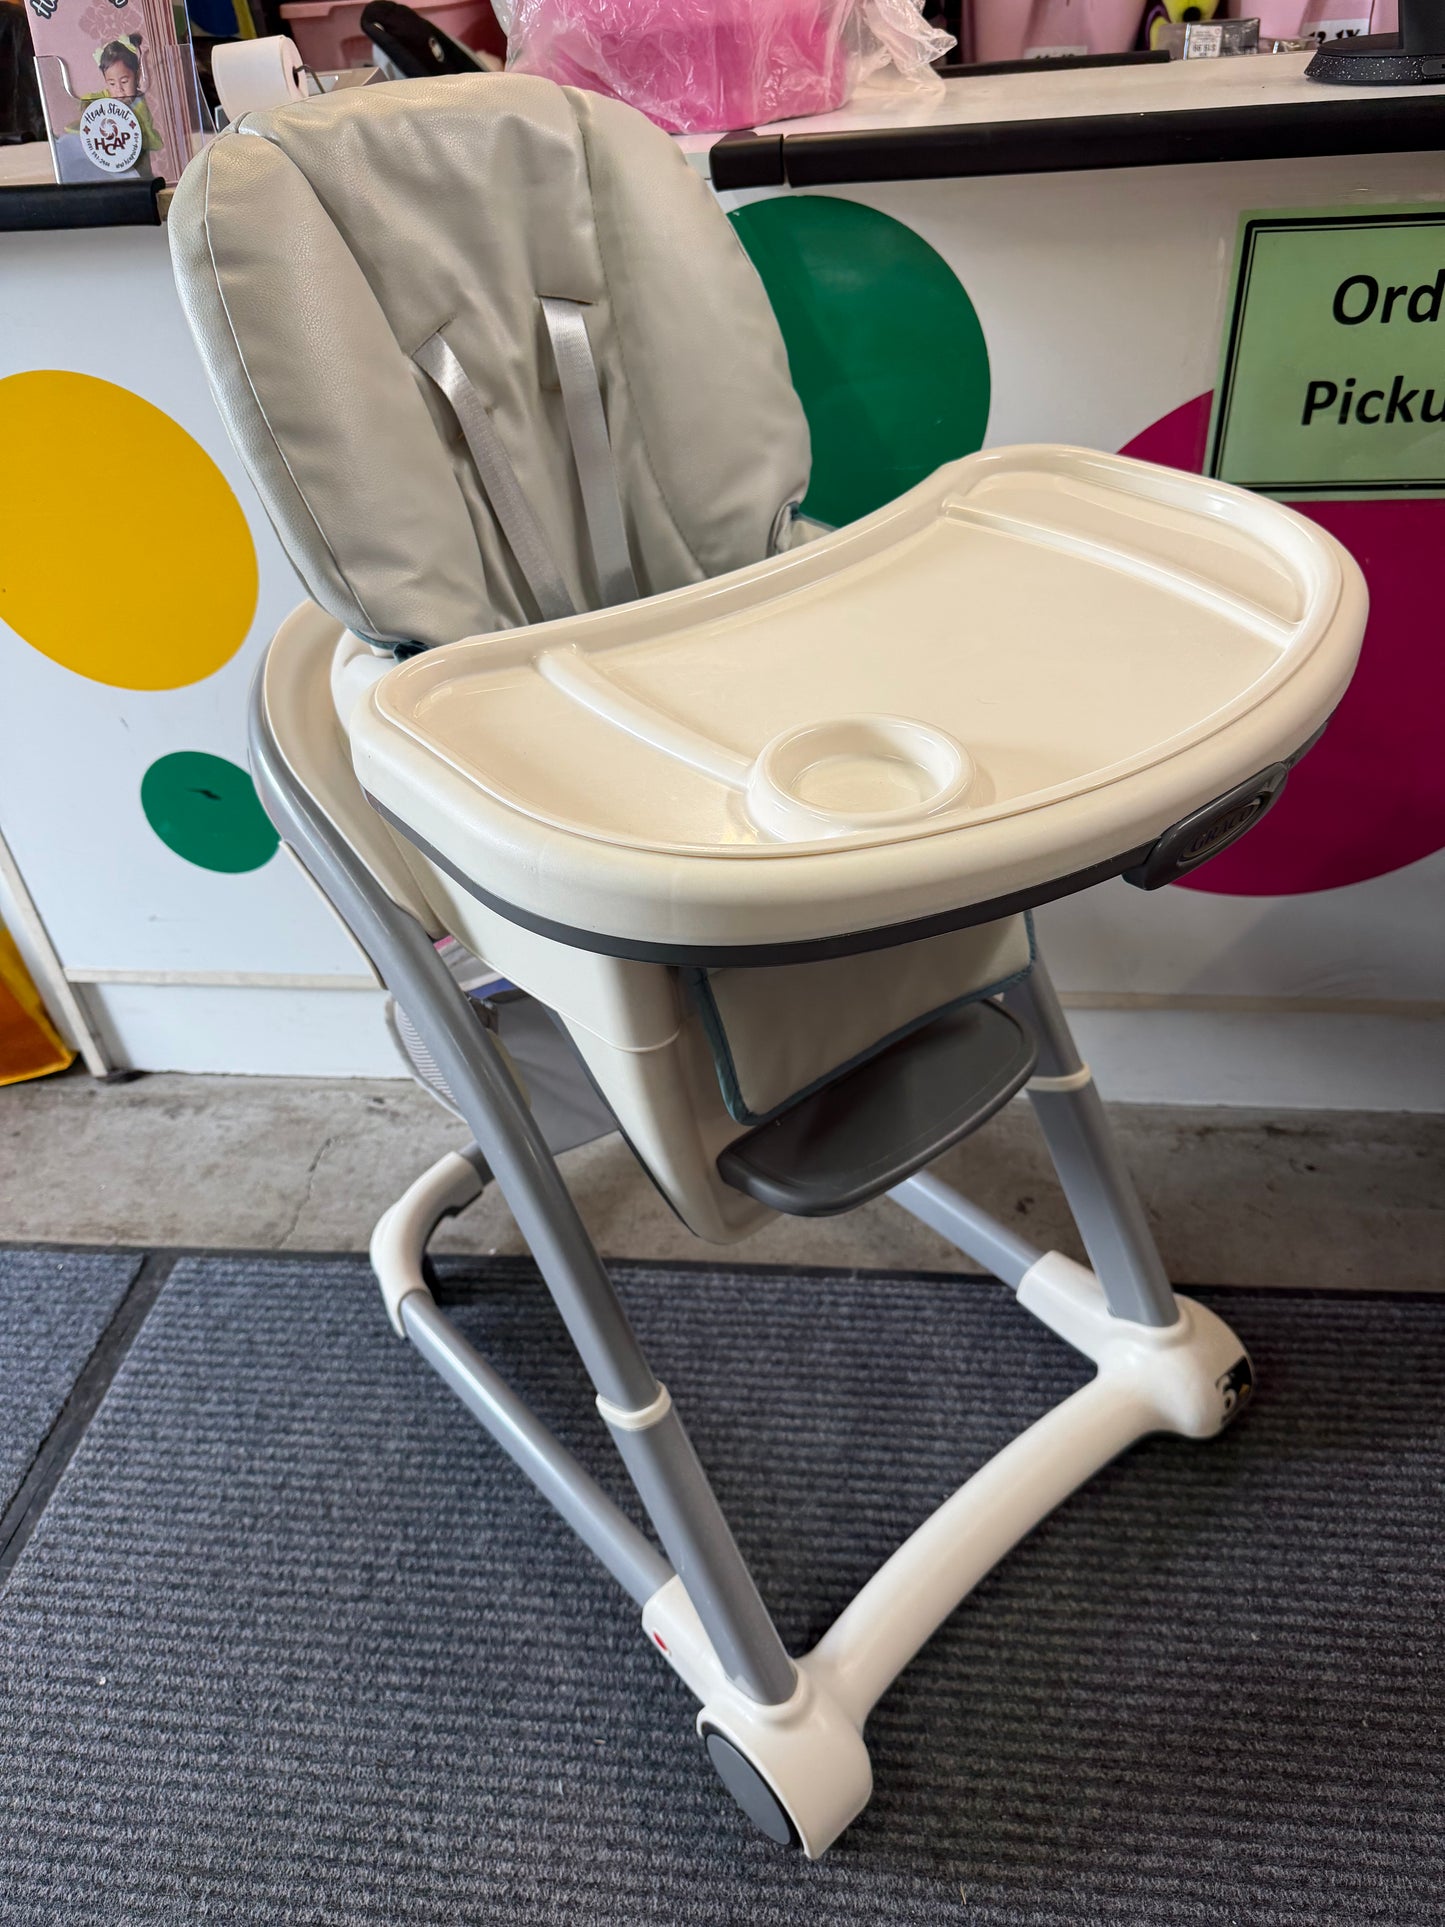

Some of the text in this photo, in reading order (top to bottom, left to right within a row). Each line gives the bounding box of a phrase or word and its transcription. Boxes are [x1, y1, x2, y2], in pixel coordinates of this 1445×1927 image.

[84, 102, 132, 124] Head Start
[94, 132, 131, 156] HCAP
[1332, 269, 1445, 326] Ord
